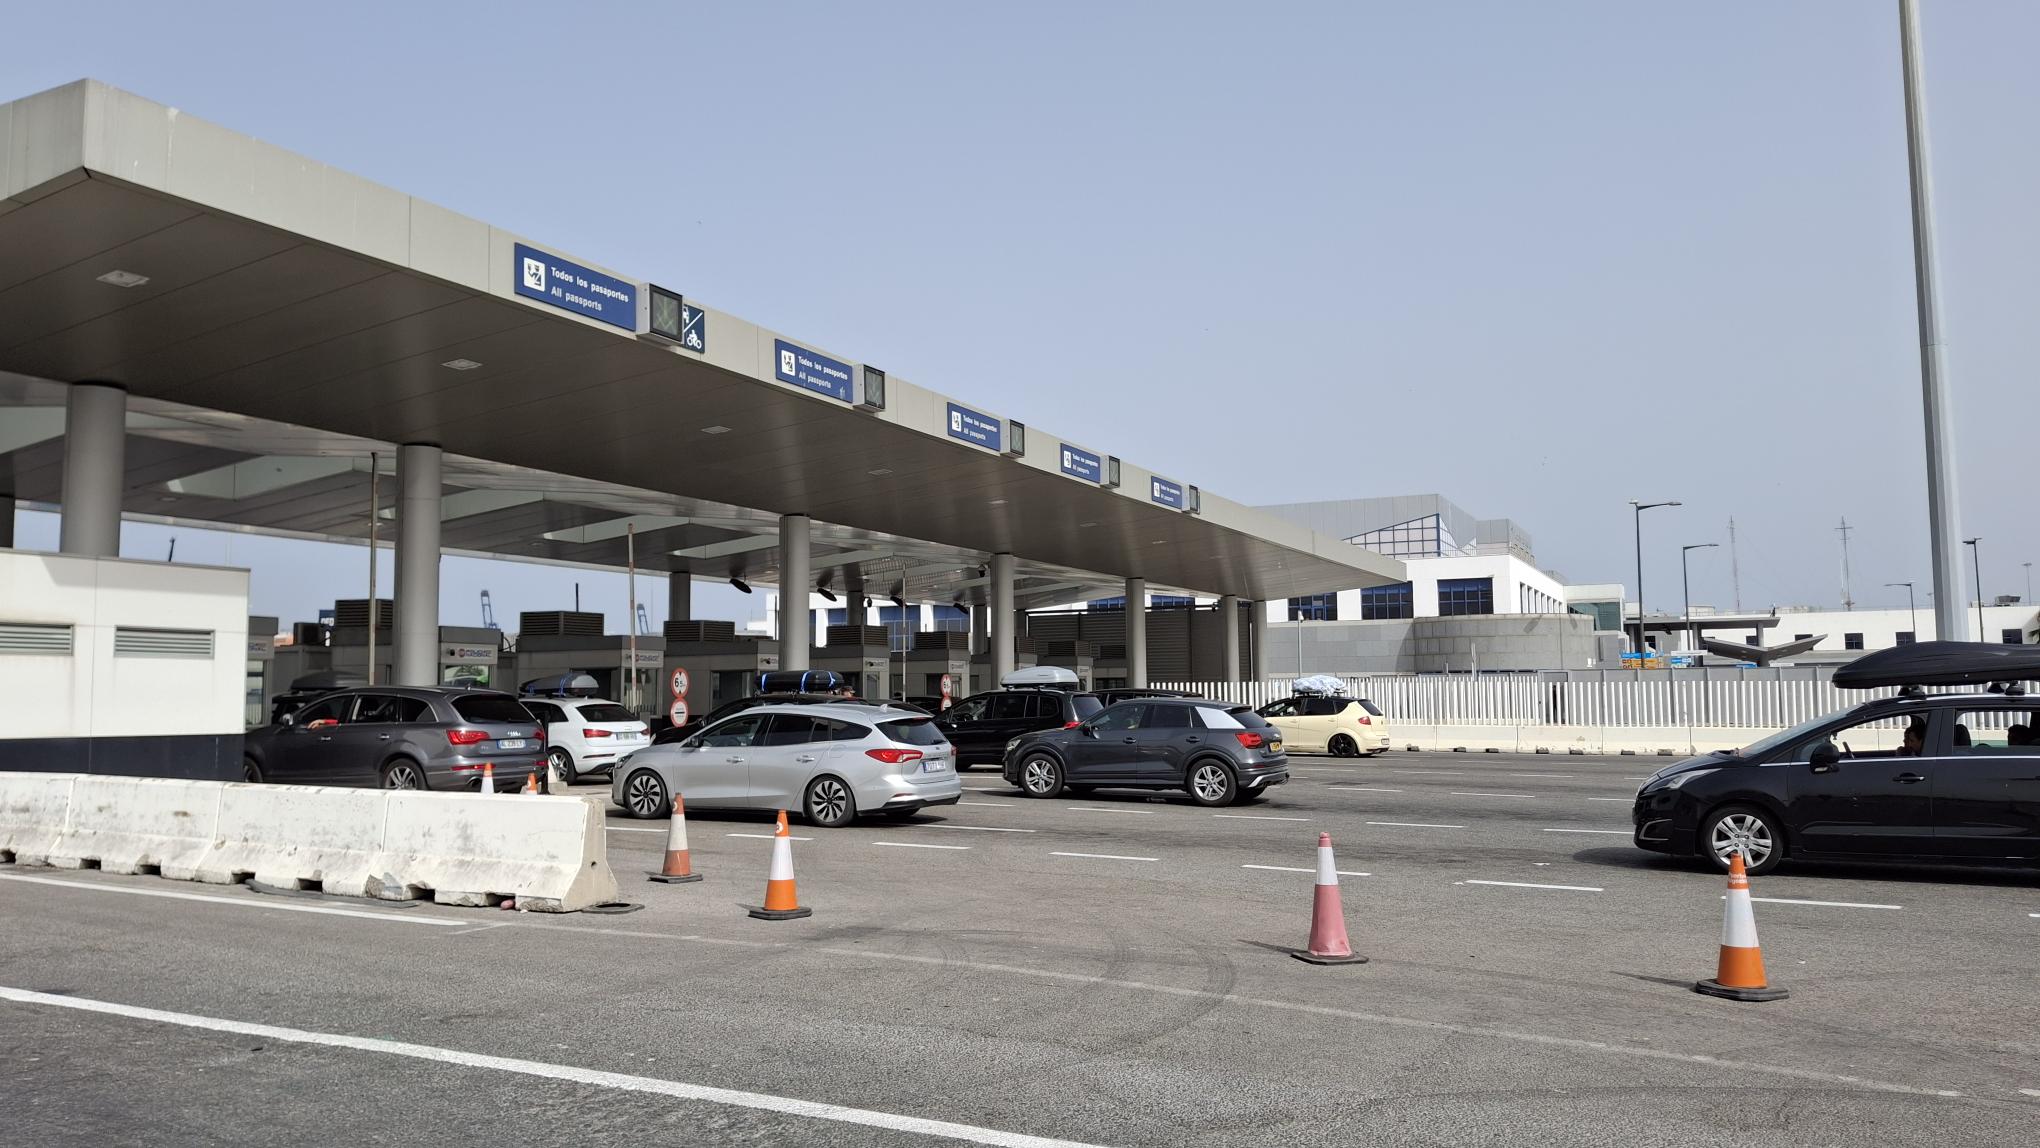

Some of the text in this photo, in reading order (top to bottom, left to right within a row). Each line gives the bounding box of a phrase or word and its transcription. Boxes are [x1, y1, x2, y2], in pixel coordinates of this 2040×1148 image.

[551, 266, 629, 303] Todos los pasaportes
[551, 286, 603, 311] All passports
[798, 356, 848, 380] Todos los pasaportes
[807, 375, 832, 389] passports
